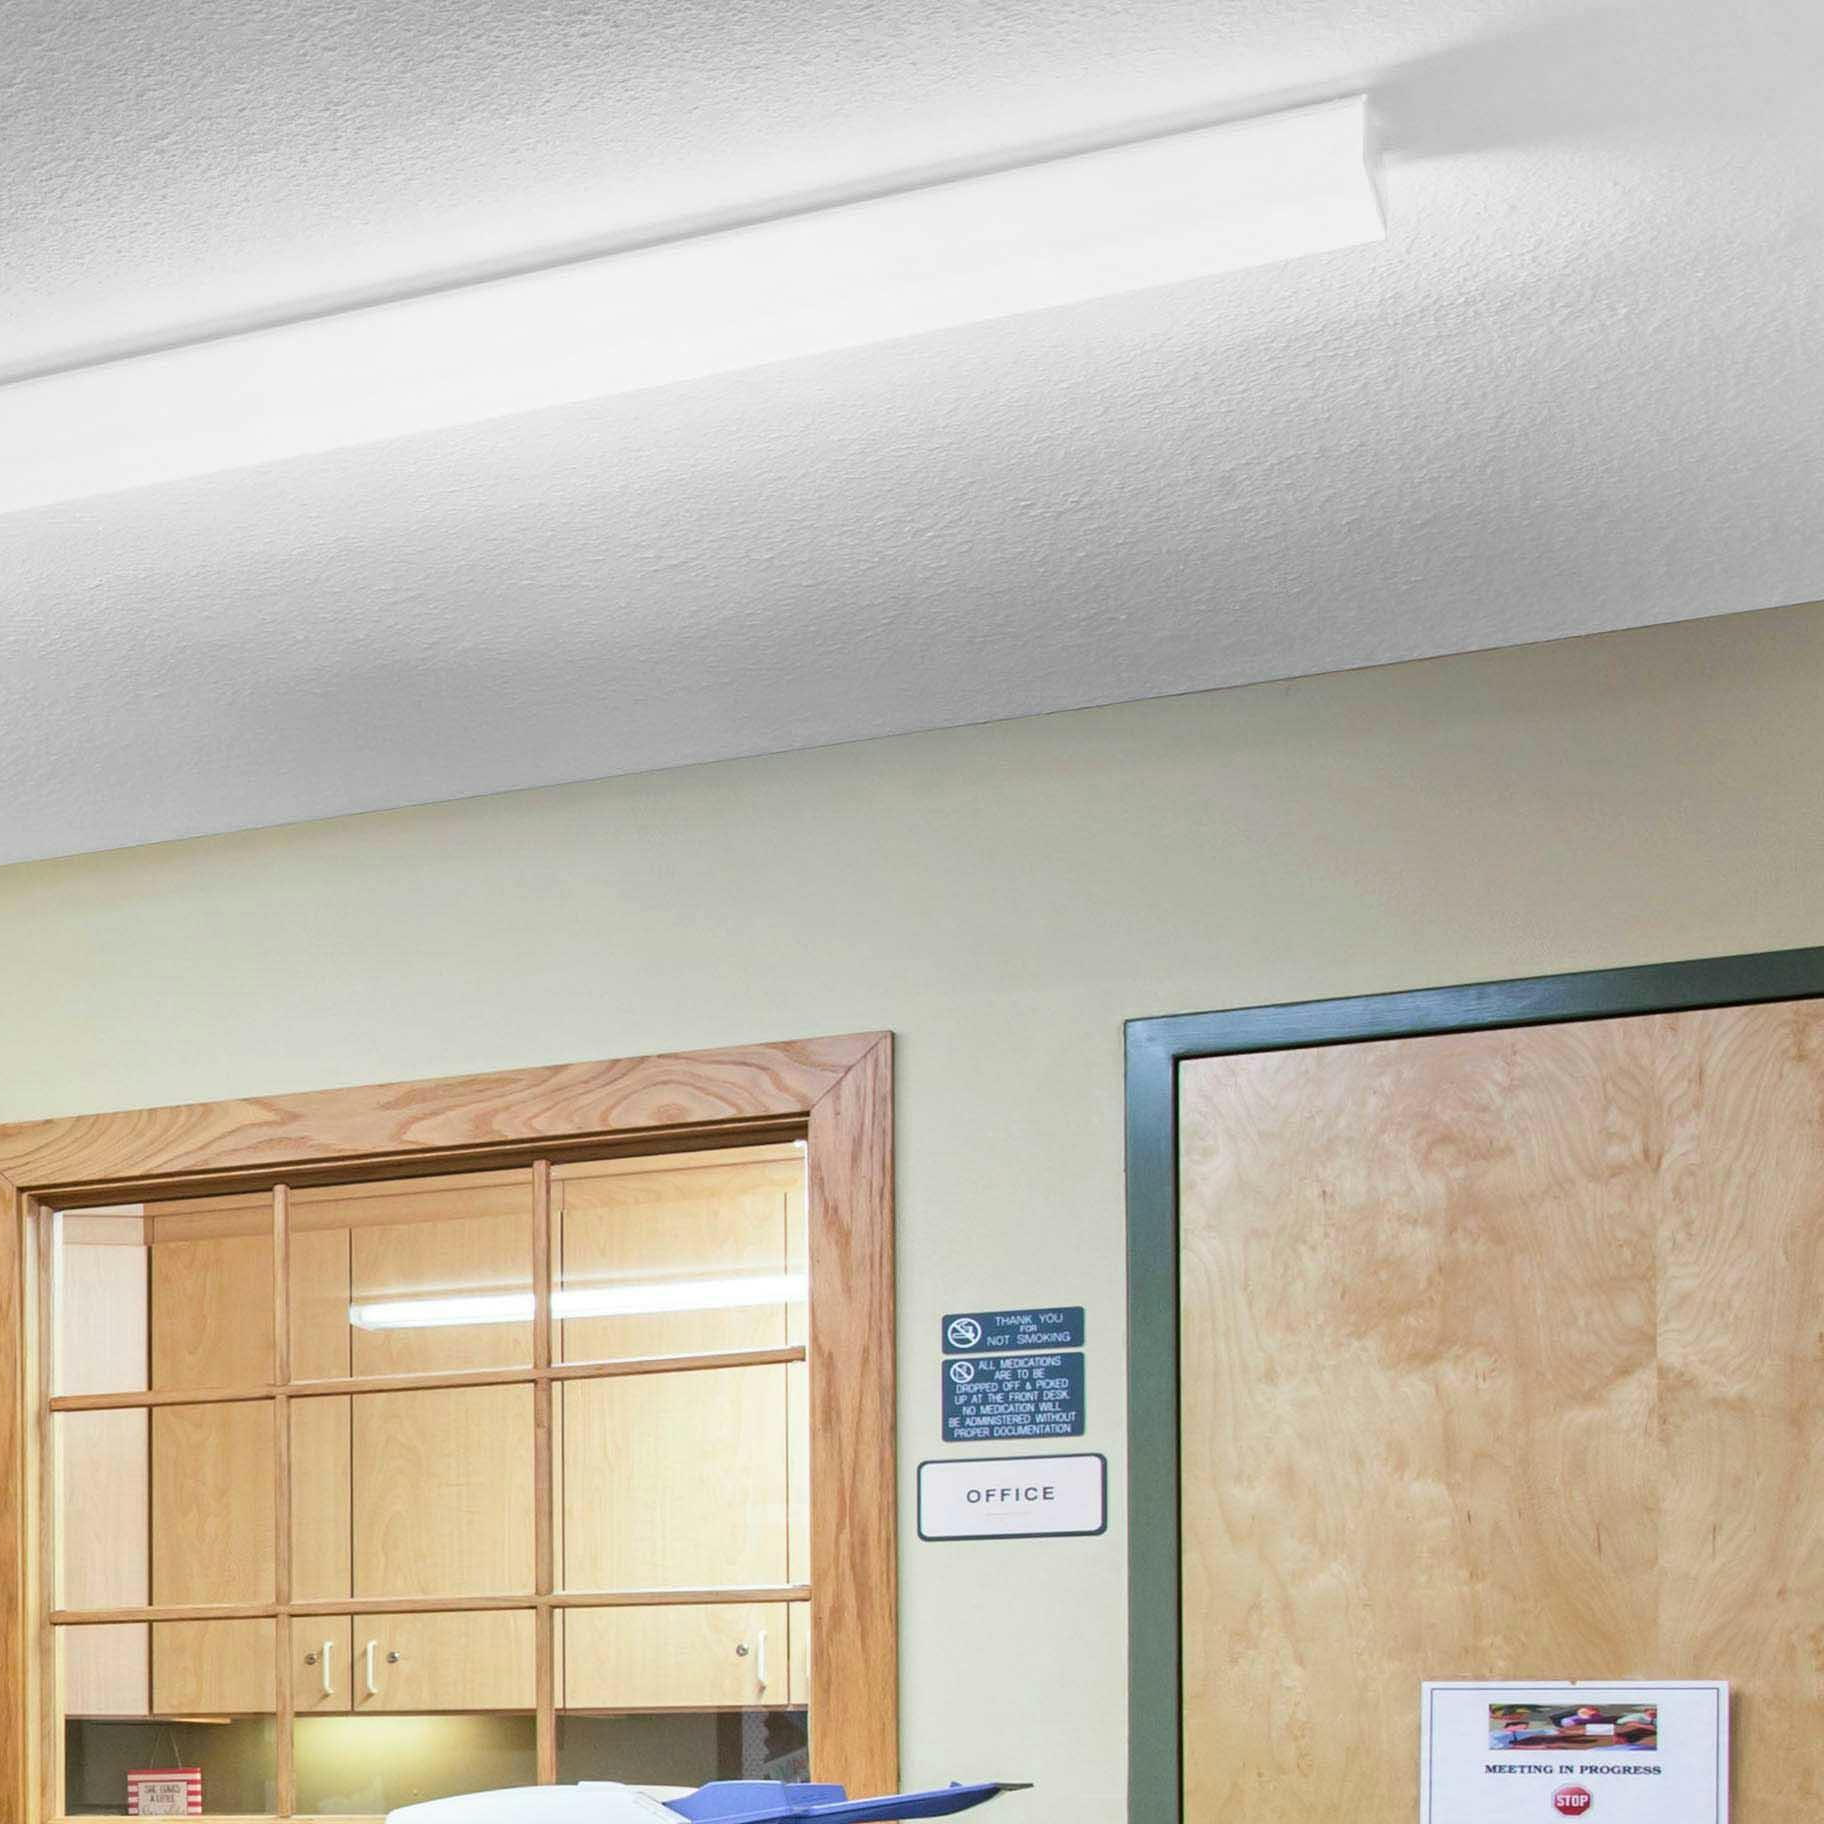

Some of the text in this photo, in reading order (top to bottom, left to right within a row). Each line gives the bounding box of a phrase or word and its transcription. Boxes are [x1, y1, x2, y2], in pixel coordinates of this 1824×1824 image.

[995, 1313, 1063, 1326] THANK YOU
[986, 1332, 1071, 1346] NOT SMOKING
[978, 1356, 1061, 1370] ALL MEDICATIONS
[994, 1369, 1045, 1380] ARE TO BE
[956, 1382, 998, 1394] DROPPED
[1002, 1381, 1021, 1391] OFF
[1036, 1379, 1068, 1388] PICKED
[954, 1395, 967, 1405] UP
[971, 1394, 985, 1404] AT
[988, 1394, 1004, 1402] THE
[1008, 1392, 1039, 1401] FRONT
[962, 1402, 1061, 1415] NO MEDICATION WILL
[948, 1412, 1076, 1426] BE ADMINISTERED WITHOUT
[954, 1424, 1072, 1438] PROPER DOCUMENTATION
[966, 1486, 1056, 1504] OFFICE
[1485, 1764, 1662, 1776] MEETING IN PROGRESS
[1556, 1794, 1589, 1808] STOP
